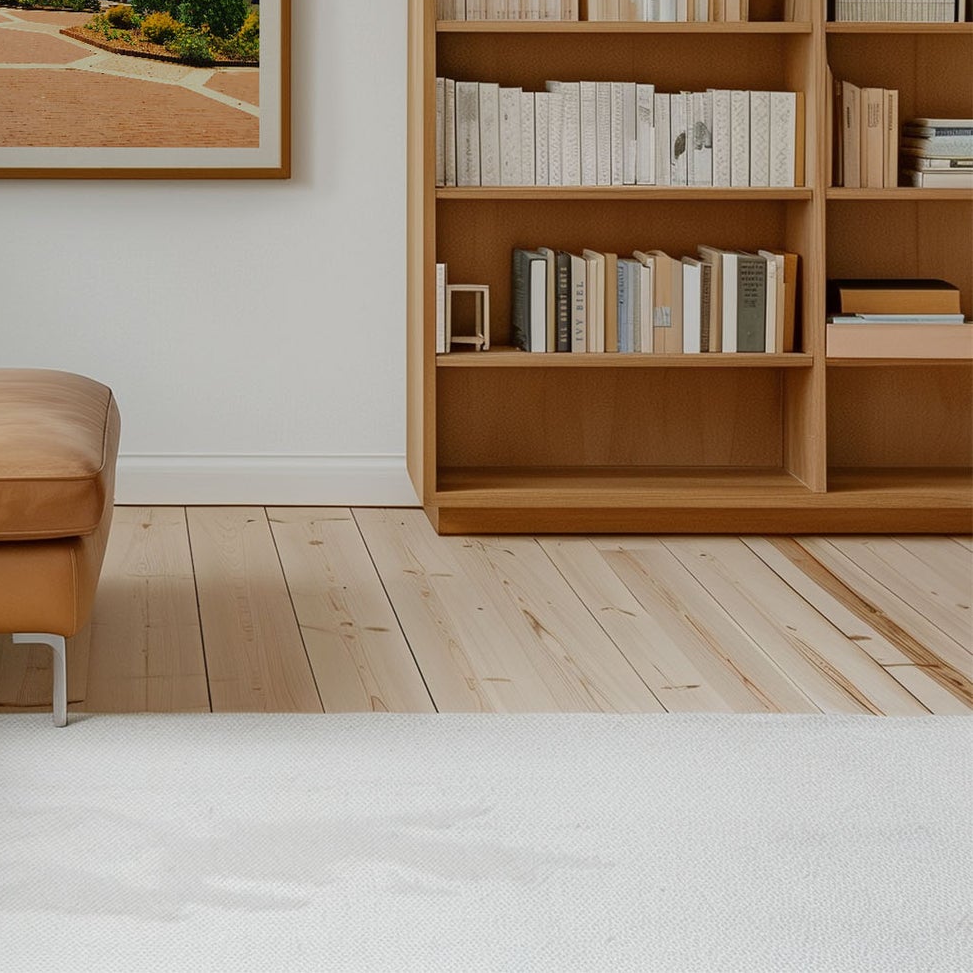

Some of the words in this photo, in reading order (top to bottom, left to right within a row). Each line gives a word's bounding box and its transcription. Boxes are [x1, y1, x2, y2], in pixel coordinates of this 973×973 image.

[560, 294, 568, 322] ABOUT
[575, 281, 585, 311] BIEL
[560, 327, 568, 343] ALL
[575, 319, 584, 342] IVY
